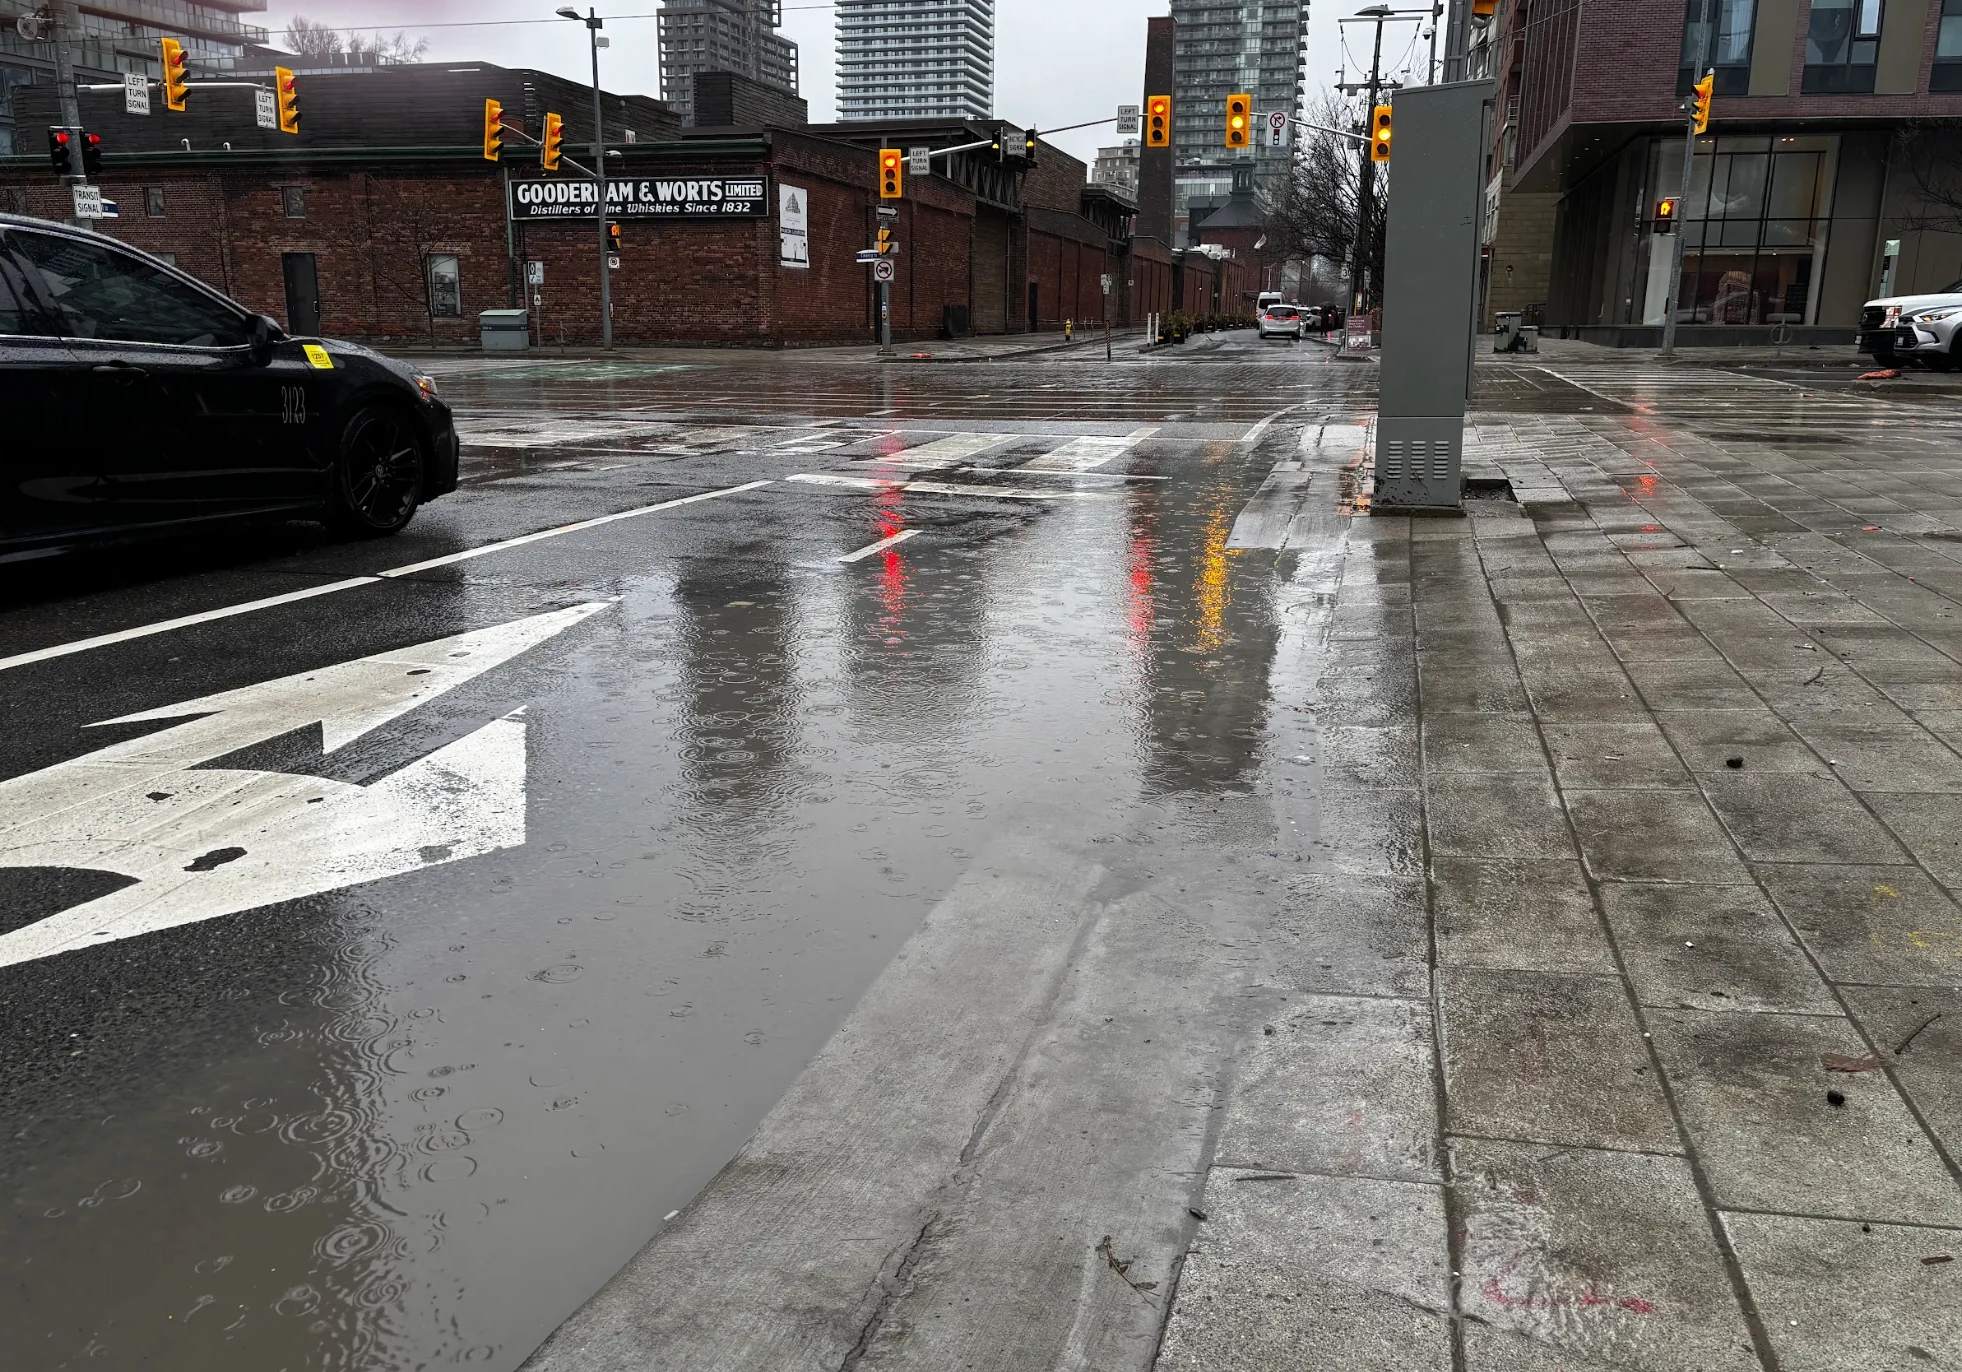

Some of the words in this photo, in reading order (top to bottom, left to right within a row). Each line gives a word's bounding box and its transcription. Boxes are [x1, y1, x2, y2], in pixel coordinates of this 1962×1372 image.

[128, 77, 144, 87] LEFT
[128, 89, 147, 98] TURN
[128, 100, 149, 109] SIGNAL
[258, 95, 272, 104] LEFT
[258, 105, 273, 113] TURN
[258, 115, 275, 125] SIGNAL
[75, 190, 99, 200] TRANSIT
[639, 182, 655, 202] &
[656, 181, 722, 201] WORTS
[725, 184, 763, 196] LIMITED
[78, 203, 100, 213] SIGNAL
[530, 205, 580, 214] Distillers
[584, 204, 596, 213] of
[603, 204, 622, 213] ine
[627, 203, 680, 213] Whiskies
[684, 203, 717, 212] Since
[722, 202, 750, 212] 1832
[281, 386, 306, 424] 3123
